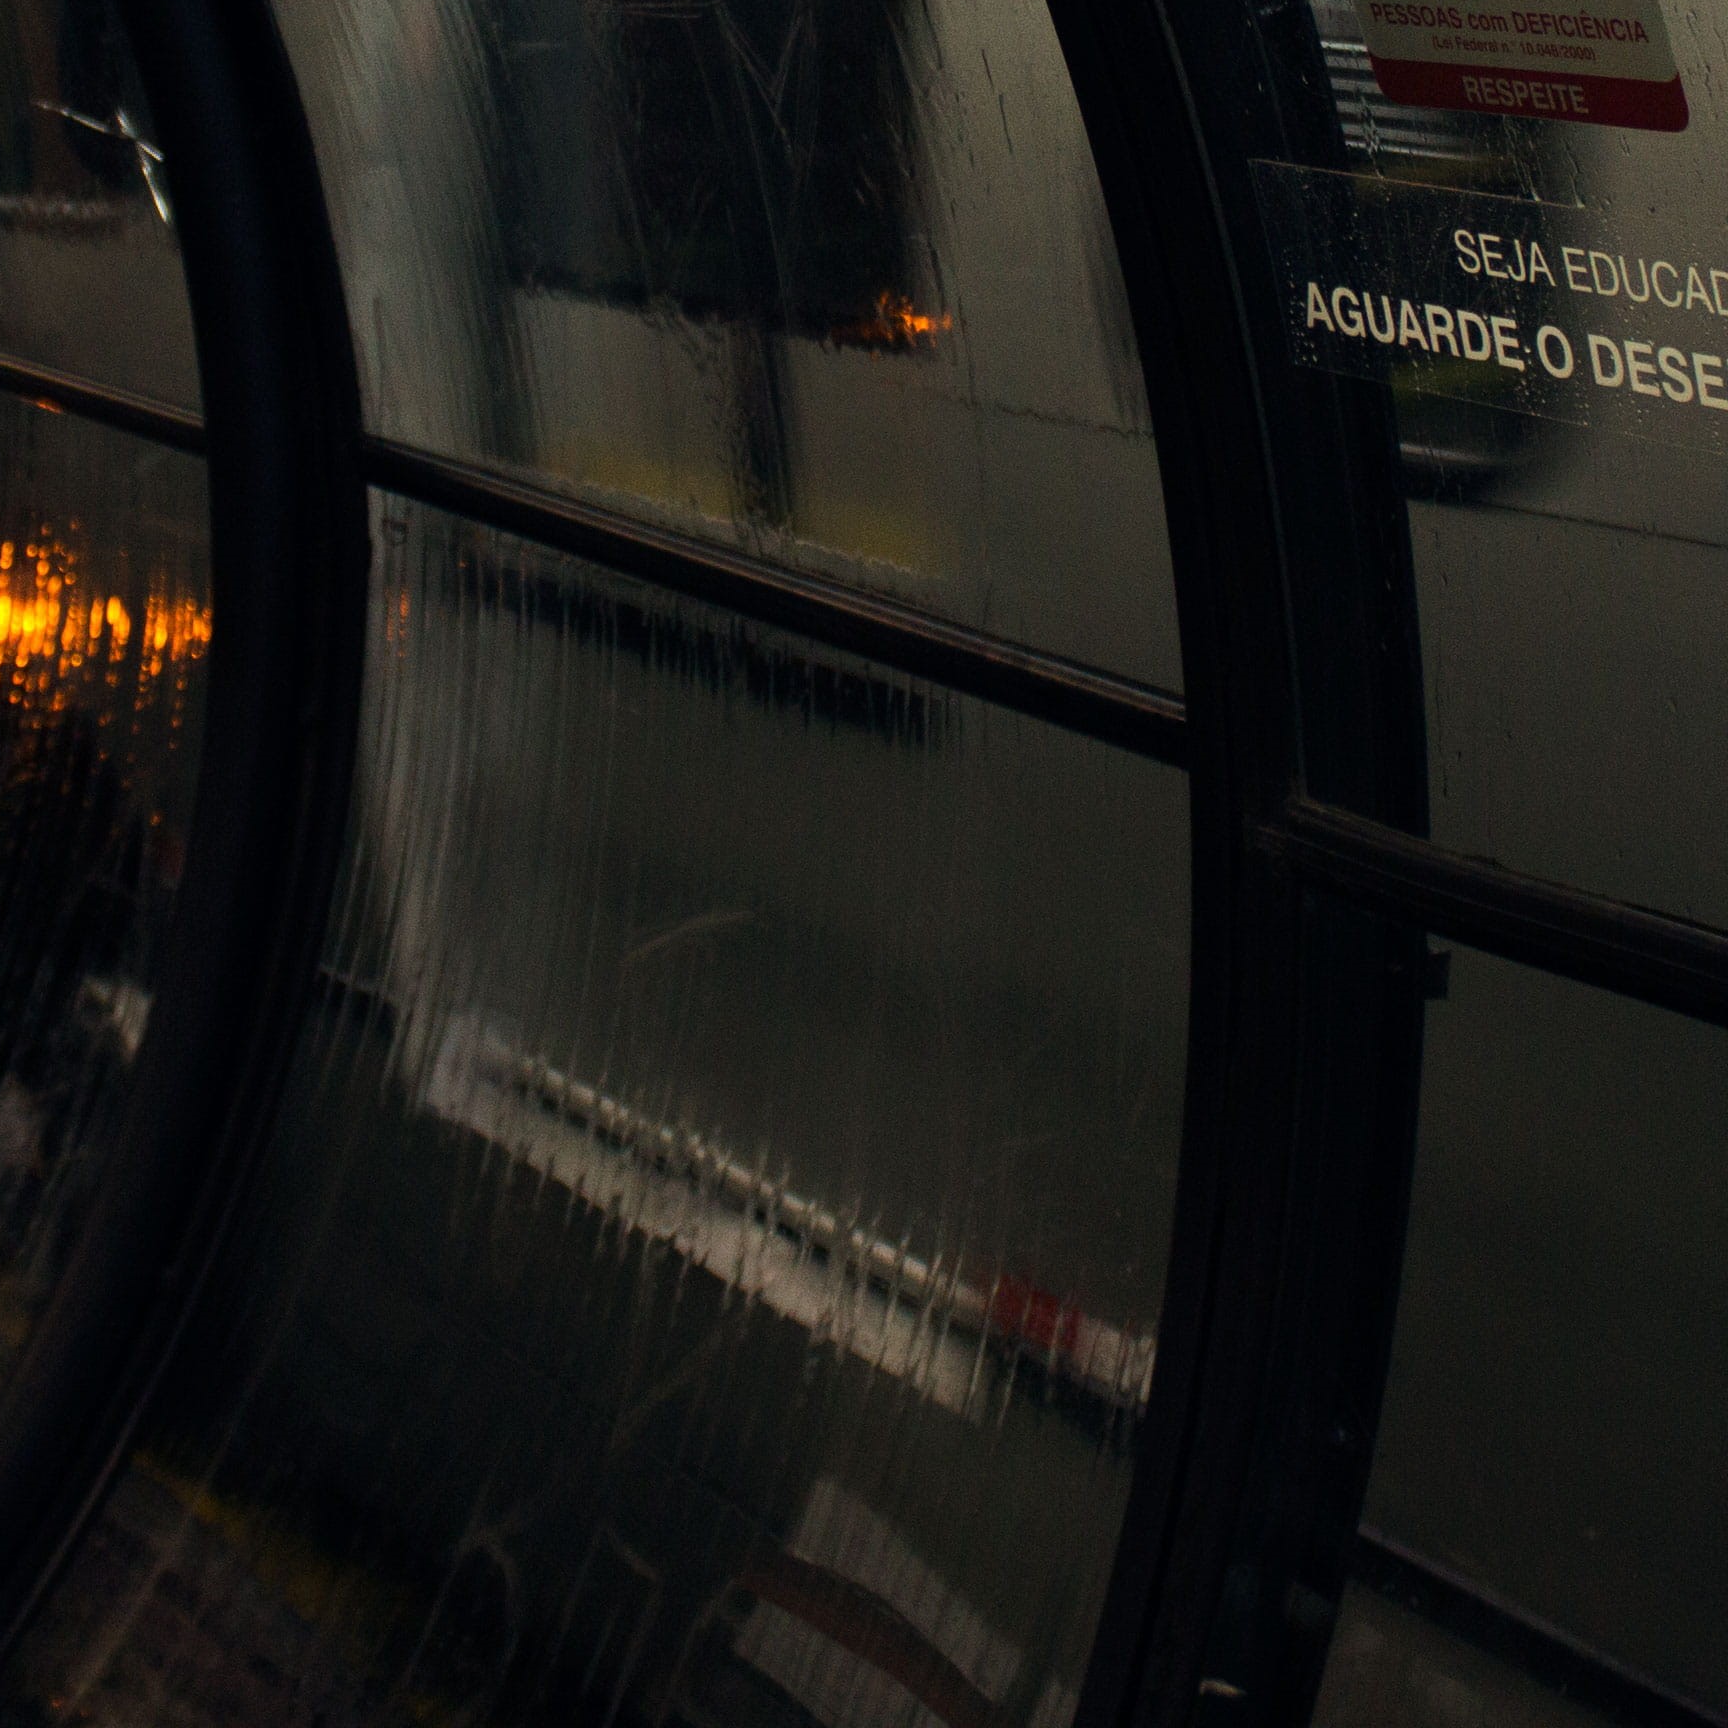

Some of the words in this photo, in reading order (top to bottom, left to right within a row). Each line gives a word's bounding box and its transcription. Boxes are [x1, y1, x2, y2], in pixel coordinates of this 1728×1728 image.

[1369, 2, 1462, 29] PESSOAS
[1467, 13, 1509, 33] com
[1512, 10, 1649, 44] DEFICIÊNCIA
[1454, 35, 1498, 54] Federal
[1461, 74, 1590, 115] RESPEITE
[1453, 228, 1558, 288] SEJA
[1304, 281, 1525, 371] AGUARDE
[1536, 324, 1574, 379] O
